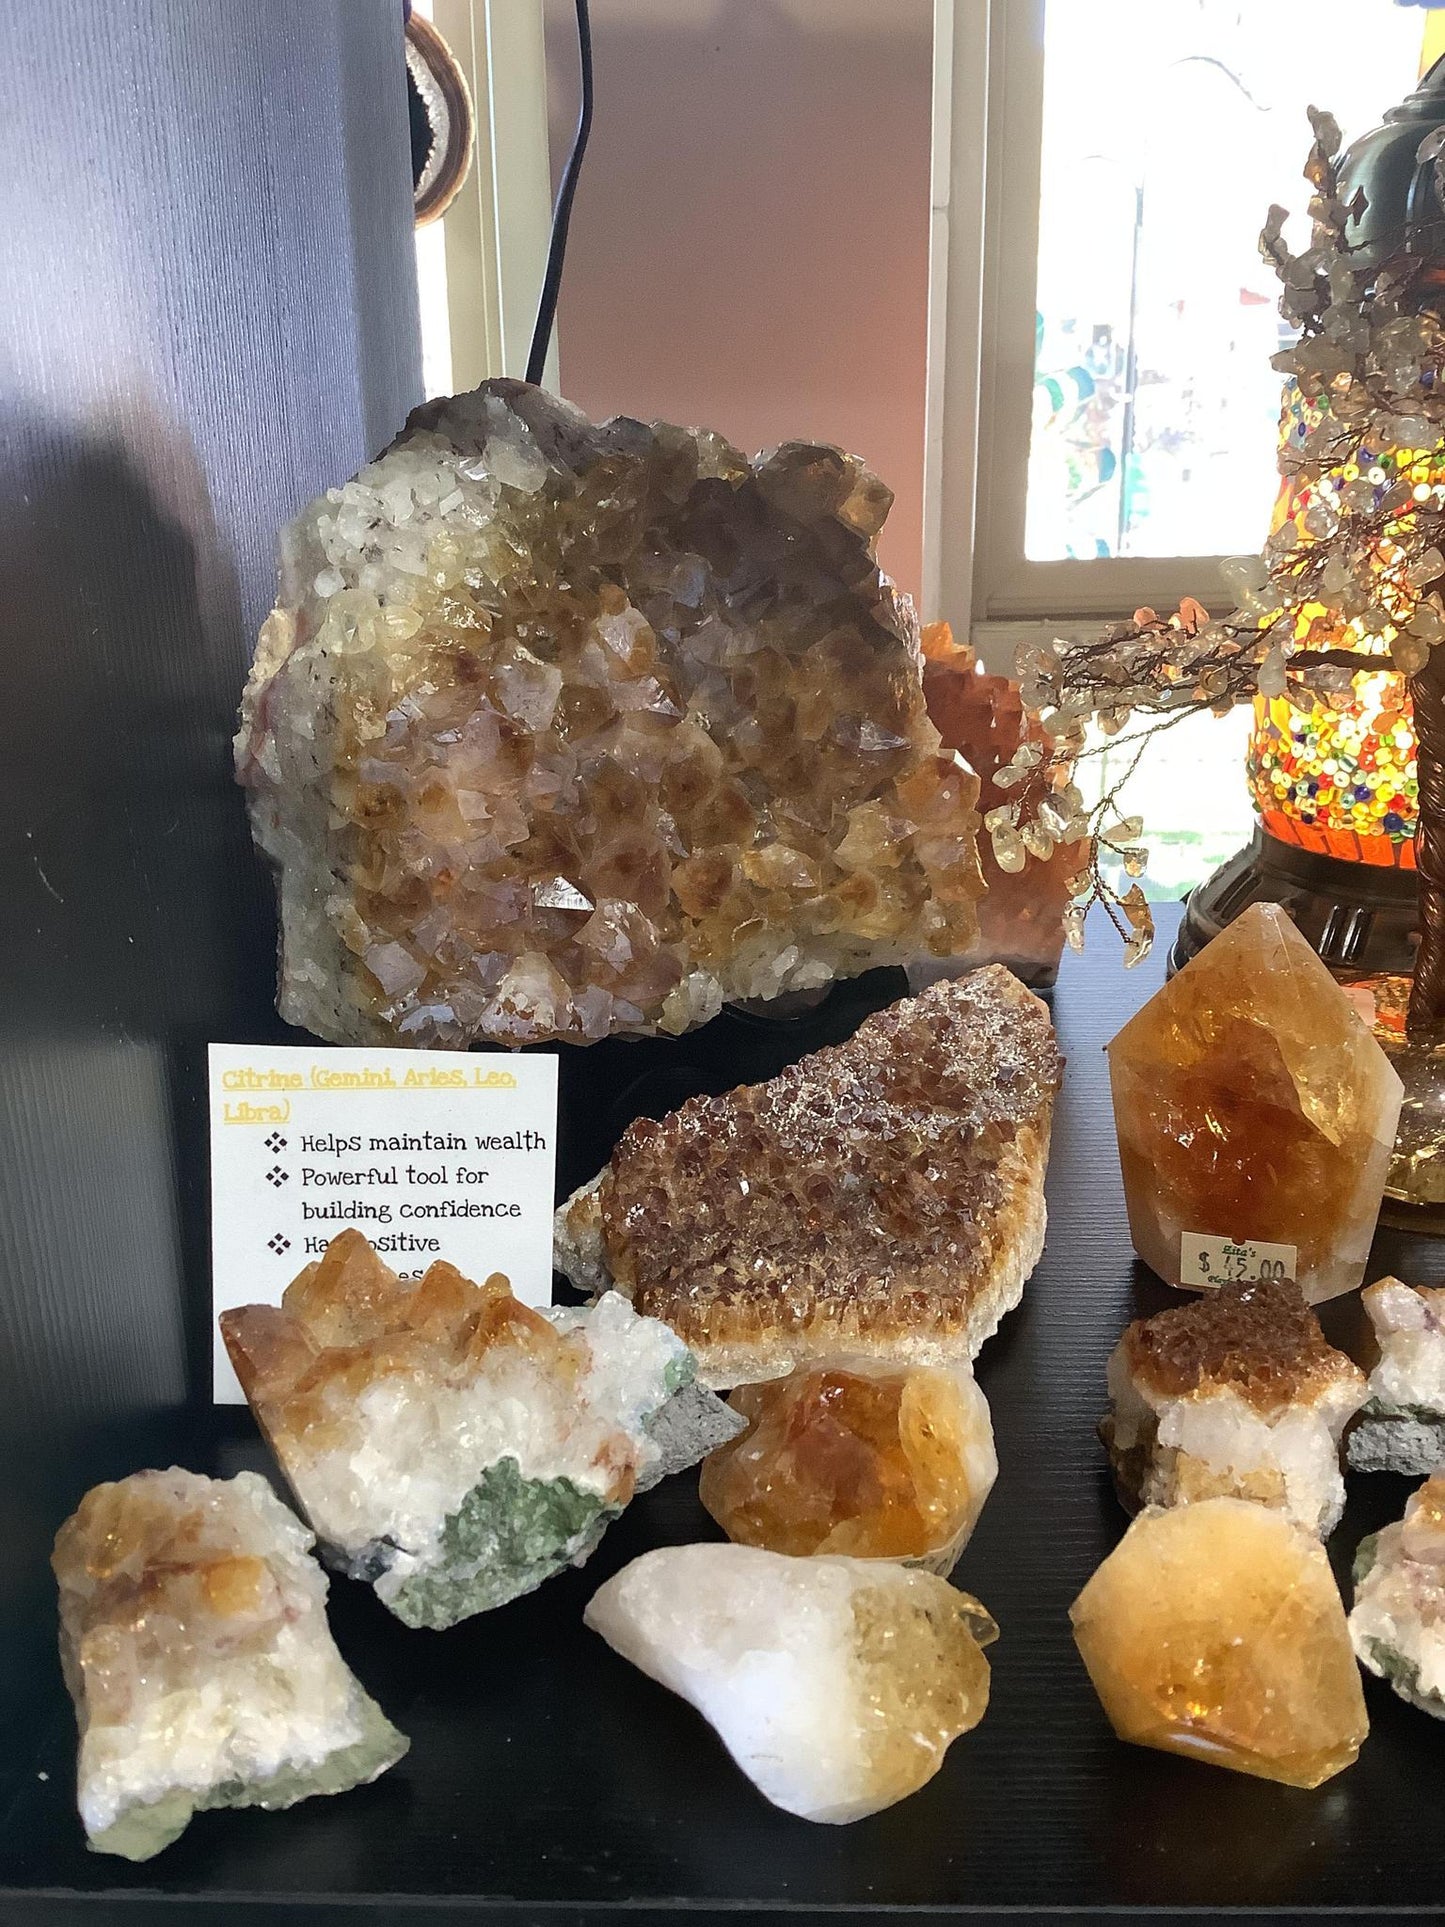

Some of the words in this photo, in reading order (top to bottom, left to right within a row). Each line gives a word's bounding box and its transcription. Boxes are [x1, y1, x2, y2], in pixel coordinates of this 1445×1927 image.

[222, 1067, 304, 1089] Citrine
[311, 1065, 397, 1088] (Gemini,
[403, 1067, 467, 1087] Aries,
[474, 1067, 517, 1087] Leo,
[223, 1099, 291, 1121] Libra)
[301, 1134, 361, 1157] Helps
[369, 1131, 467, 1151] maintain
[475, 1130, 547, 1152] wealth
[302, 1167, 398, 1187] Powerful
[406, 1165, 448, 1185] tool
[456, 1167, 489, 1184] for
[302, 1200, 392, 1224] building
[399, 1199, 522, 1218] confidence
[304, 1237, 329, 1253] Ha
[366, 1232, 441, 1252] ositive
